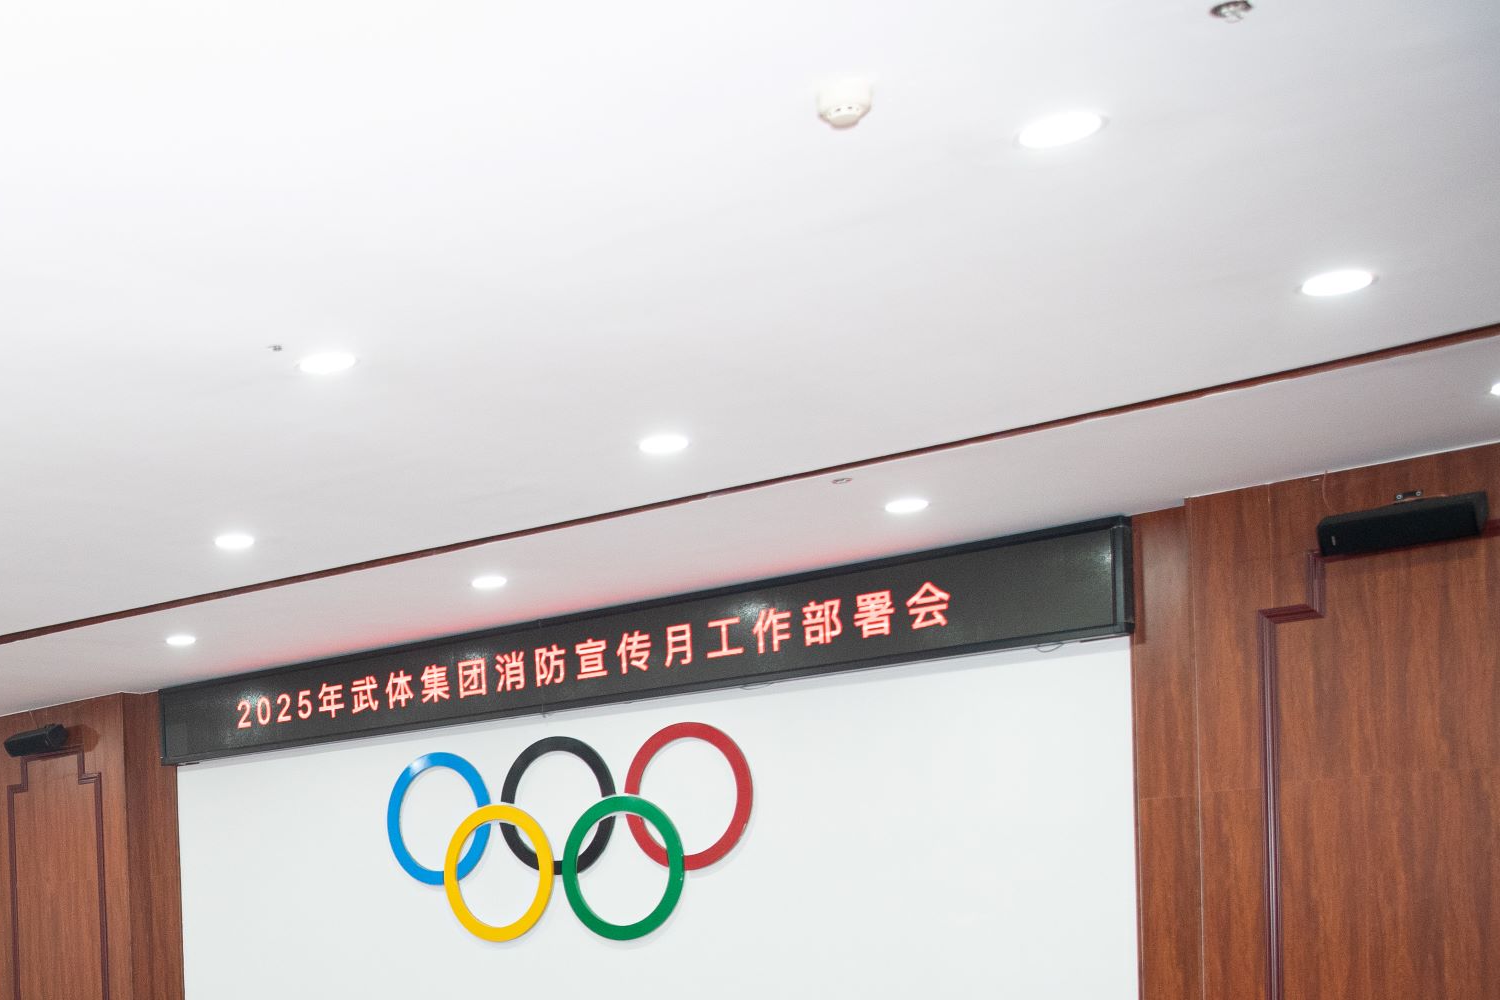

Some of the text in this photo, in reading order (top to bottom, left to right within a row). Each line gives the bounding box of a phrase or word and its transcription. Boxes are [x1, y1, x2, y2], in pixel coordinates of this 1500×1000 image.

[236, 581, 952, 729] 2025年武体集团消防宣传月工作部署会
